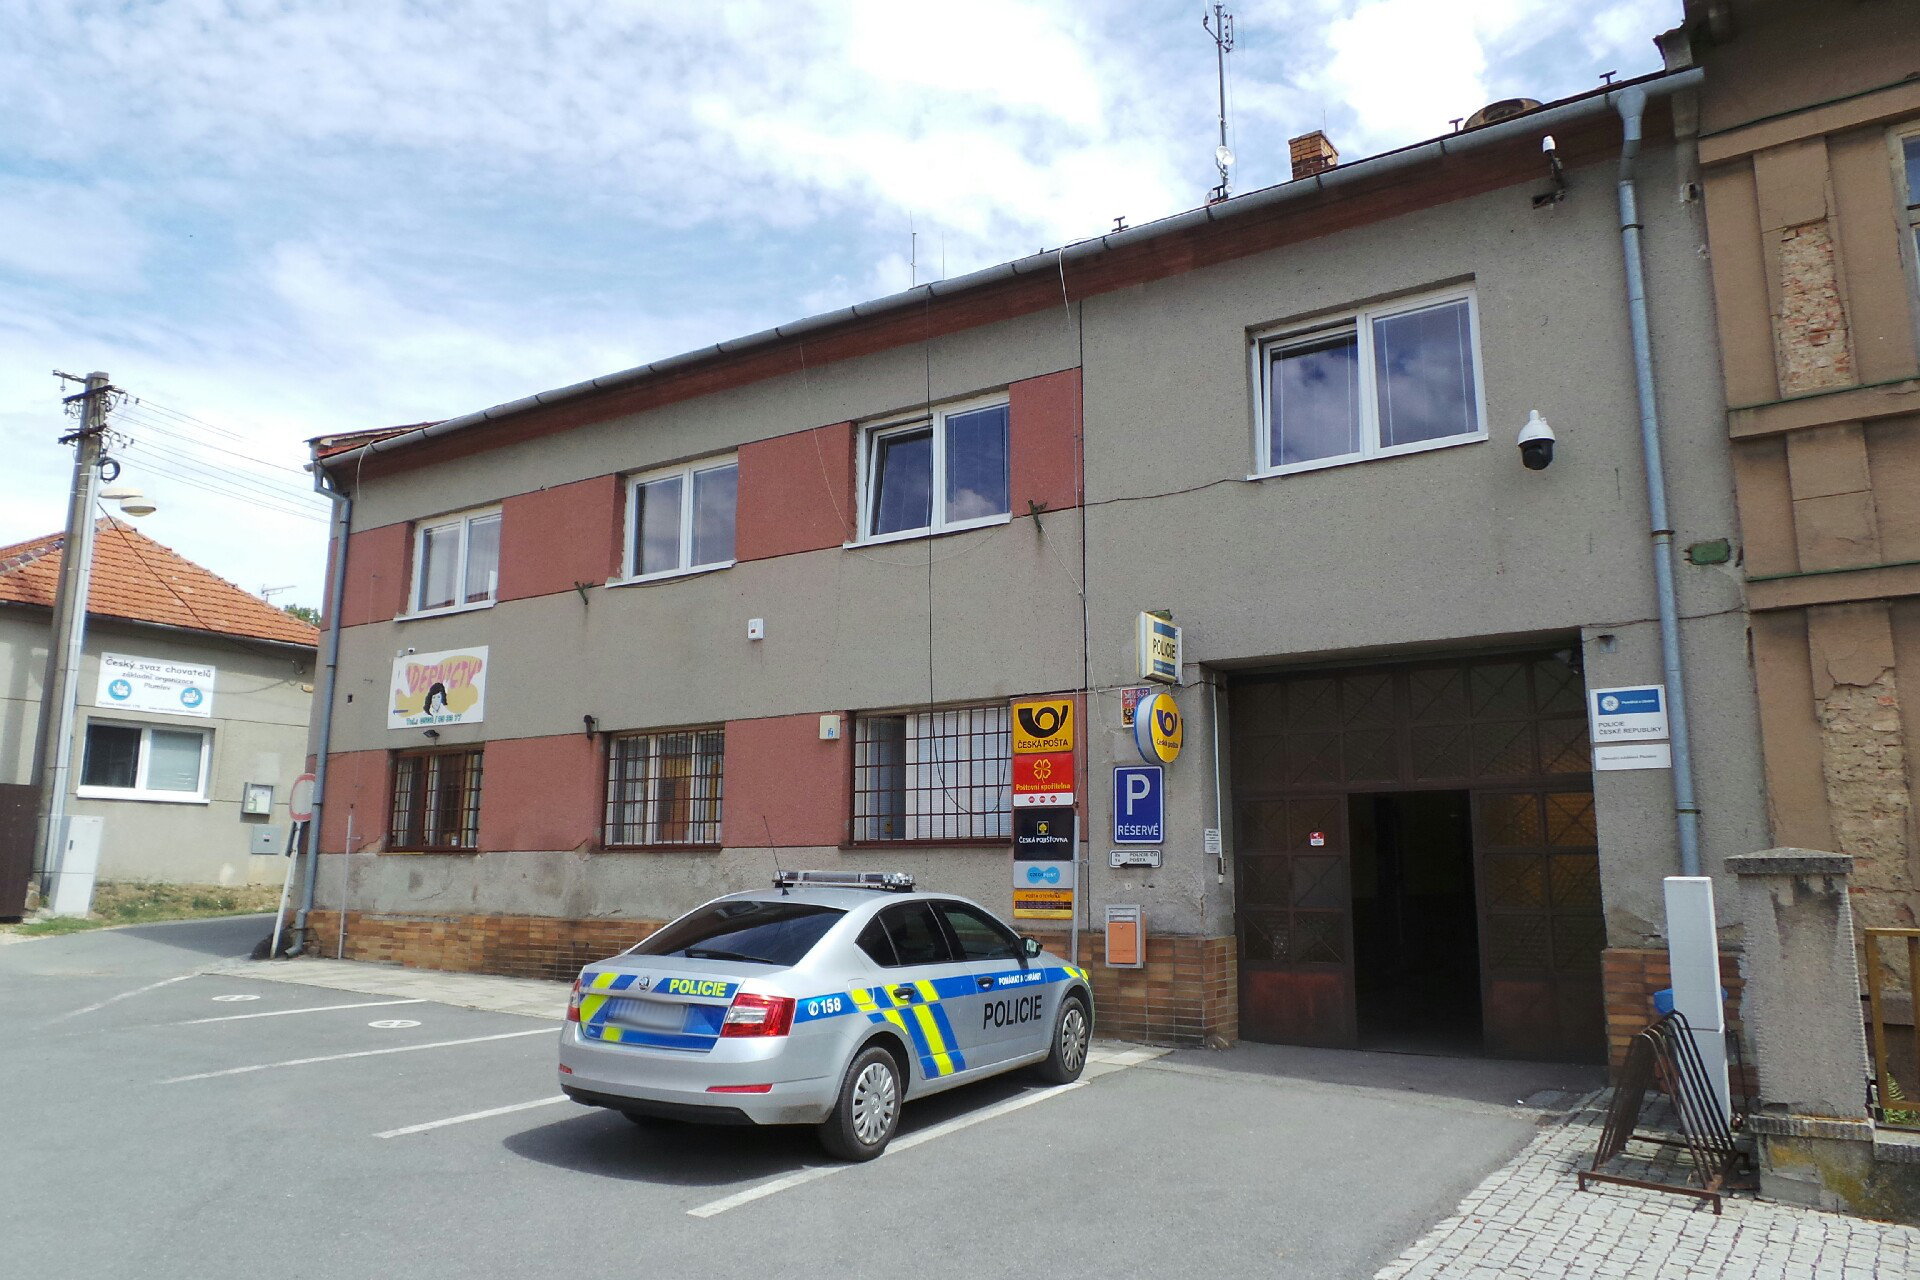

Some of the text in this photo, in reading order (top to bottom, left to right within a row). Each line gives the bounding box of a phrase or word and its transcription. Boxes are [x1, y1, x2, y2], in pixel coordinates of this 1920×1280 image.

[1152, 638, 1176, 660] POLICIE
[105, 656, 135, 670] Český
[140, 663, 161, 672] svaz
[155, 677, 195, 685] organizace
[1623, 726, 1662, 734] REPUBLIKY
[1017, 738, 1069, 749] ČESKÁ POŠTA
[1156, 738, 1168, 747] Česká
[1015, 782, 1071, 791] Poštovní spořitelna
[1126, 773, 1151, 816] P
[1117, 823, 1159, 836] RÉSERVÉ
[1018, 836, 1036, 844] ČESKÁ
[668, 979, 728, 997] POLICIE
[820, 997, 842, 1014] 158
[983, 995, 1042, 1030] POLICIE
